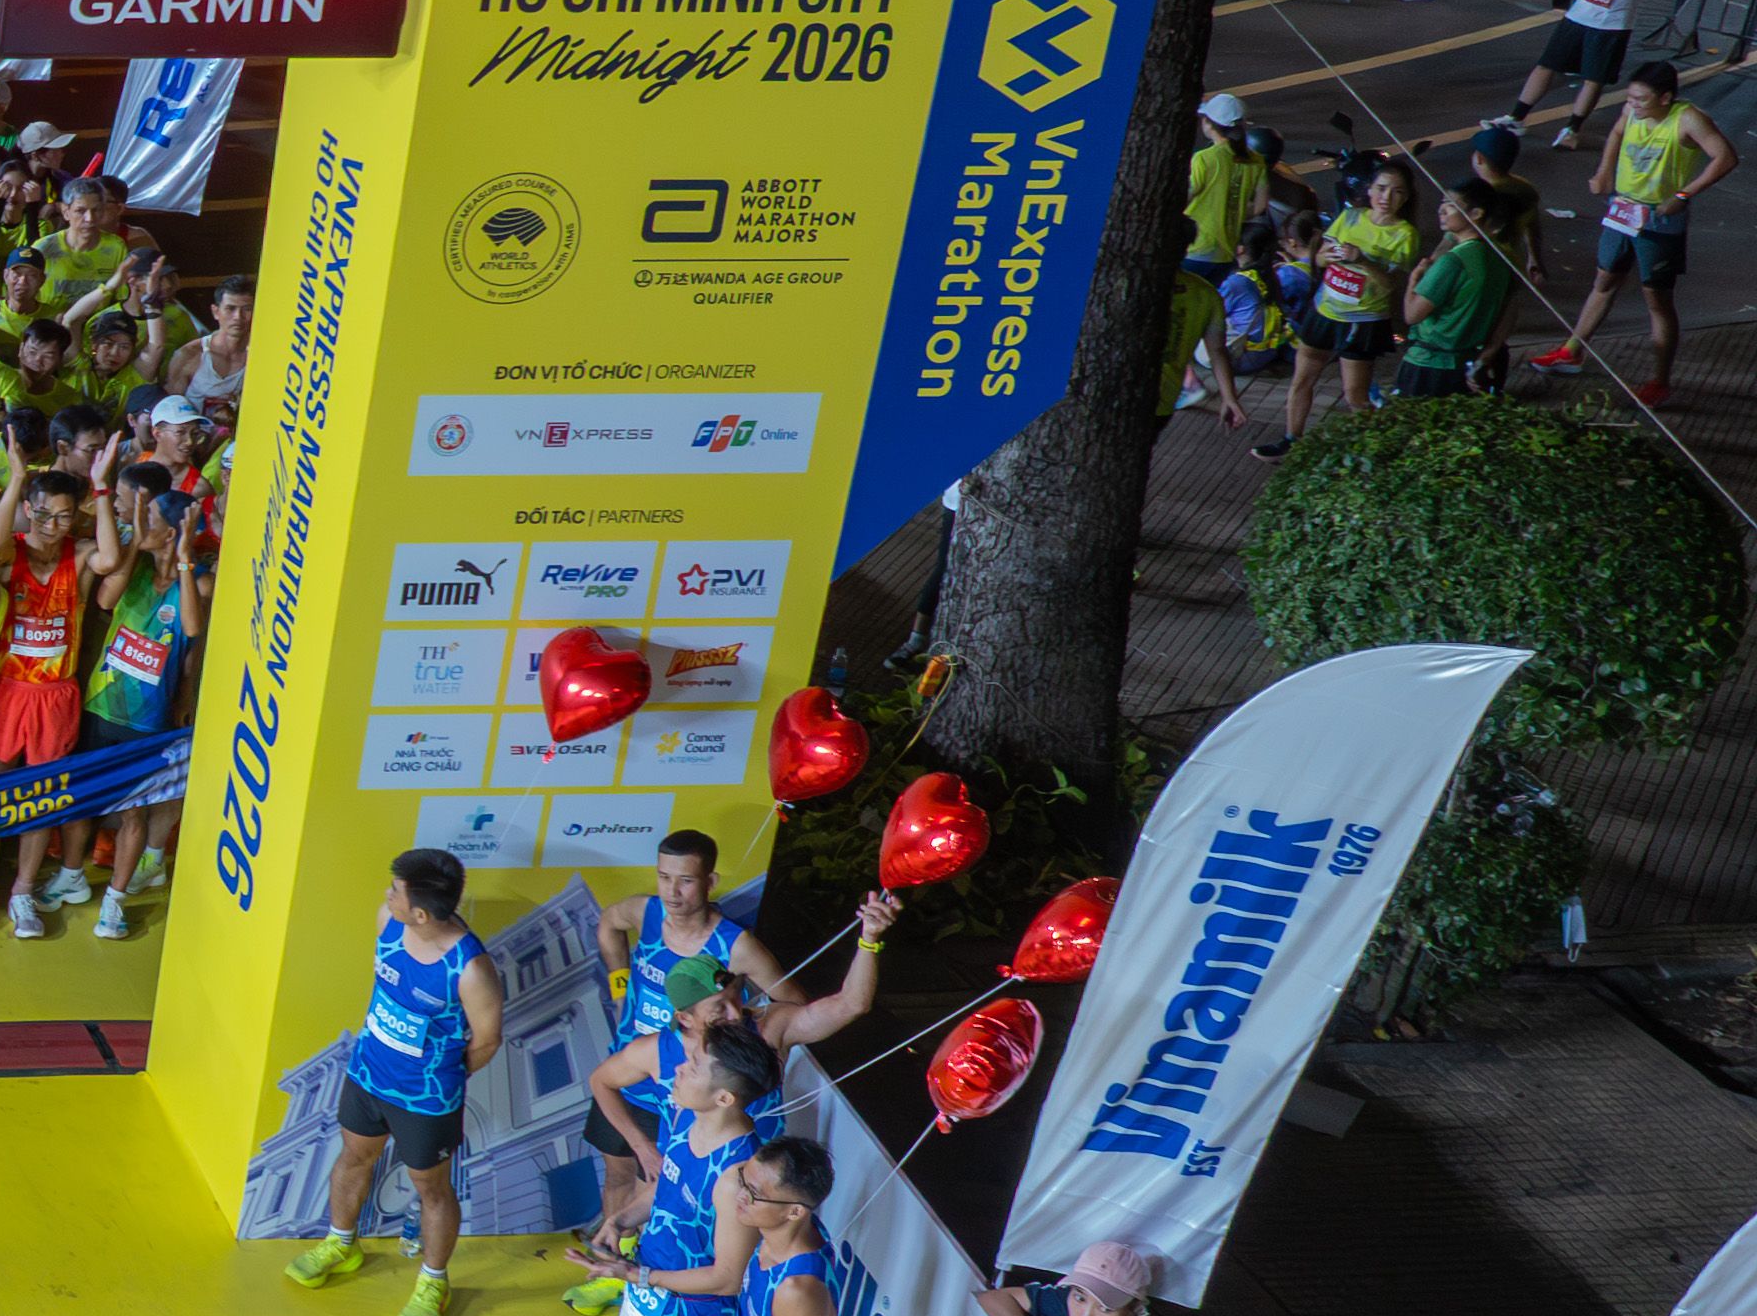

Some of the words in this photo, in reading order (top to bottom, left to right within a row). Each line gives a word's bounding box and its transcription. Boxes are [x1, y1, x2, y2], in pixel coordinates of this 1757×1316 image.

[470, 25, 760, 102] Midnight
[763, 22, 892, 84] 2026
[316, 129, 338, 187] HO
[741, 179, 823, 193] ABBOTT
[740, 195, 813, 210] WORLD
[305, 190, 329, 258] CHI
[736, 212, 856, 226] MARATHON
[733, 229, 819, 244] MAJORS
[490, 252, 529, 261] WORLD
[915, 130, 1020, 400] Marathon
[980, 117, 1086, 399] VnExpress
[479, 262, 538, 271] ATHLETICS
[690, 272, 747, 285] WANDA
[752, 272, 785, 285] AGE
[788, 271, 844, 285] GROUP
[304, 156, 364, 430] VNEXPRESS
[693, 292, 774, 306] QUALIFIER
[290, 258, 319, 361] MINH
[494, 364, 539, 380] ĐƠN
[541, 364, 560, 385] VỊ
[561, 358, 588, 380] TỔ
[589, 361, 643, 380] CHỨC
[655, 362, 757, 380] ORGANIZER
[279, 362, 304, 447] CITY
[515, 421, 653, 448] VNEXPRESS
[691, 414, 757, 453] FPT
[760, 427, 799, 442] Online
[515, 506, 549, 525] ĐỐI
[551, 507, 585, 525] TÁC
[597, 509, 684, 525] PARTNERS
[264, 427, 321, 690] MARATHON
[540, 564, 640, 585] ReVive
[710, 569, 766, 587] PVI
[400, 582, 482, 606] PUMA
[584, 585, 630, 598] PRO
[710, 587, 768, 596] INSURANCE
[25, 628, 65, 642] 80979
[124, 644, 161, 669] 81601
[419, 645, 447, 660] TH
[415, 661, 464, 681] true
[412, 682, 461, 694] WATER
[686, 732, 725, 743] Cancer
[396, 748, 417, 759] NHÀ
[419, 747, 455, 759] THUỐC
[685, 742, 726, 754] Council
[383, 761, 416, 773] LONG
[418, 759, 462, 773] CHÂU
[216, 659, 279, 912] 2026
[583, 824, 652, 837] phiten
[1082, 808, 1336, 1161] Vinamilk
[1181, 1139, 1225, 1178] EST
[1329, 821, 1382, 878] 1976
